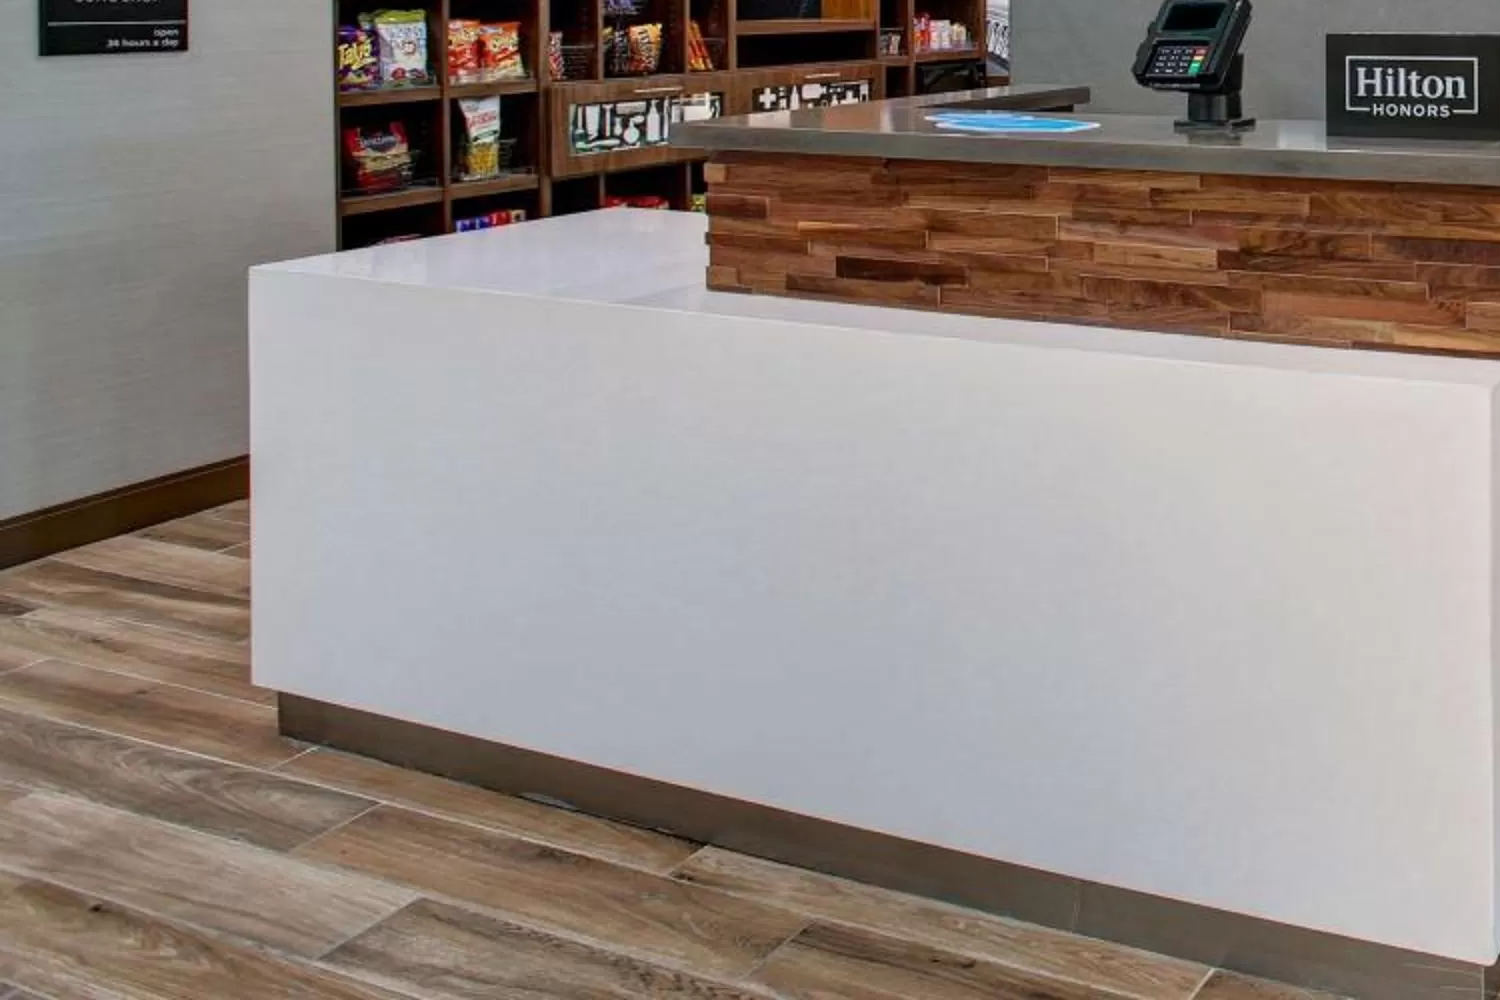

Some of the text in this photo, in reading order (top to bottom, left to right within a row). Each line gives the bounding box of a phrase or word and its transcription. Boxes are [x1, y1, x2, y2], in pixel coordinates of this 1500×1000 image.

[153, 27, 179, 38] open
[121, 37, 151, 47] hours
[161, 37, 179, 48] day
[1355, 66, 1467, 99] Hilton
[1372, 103, 1451, 118] HONORS
